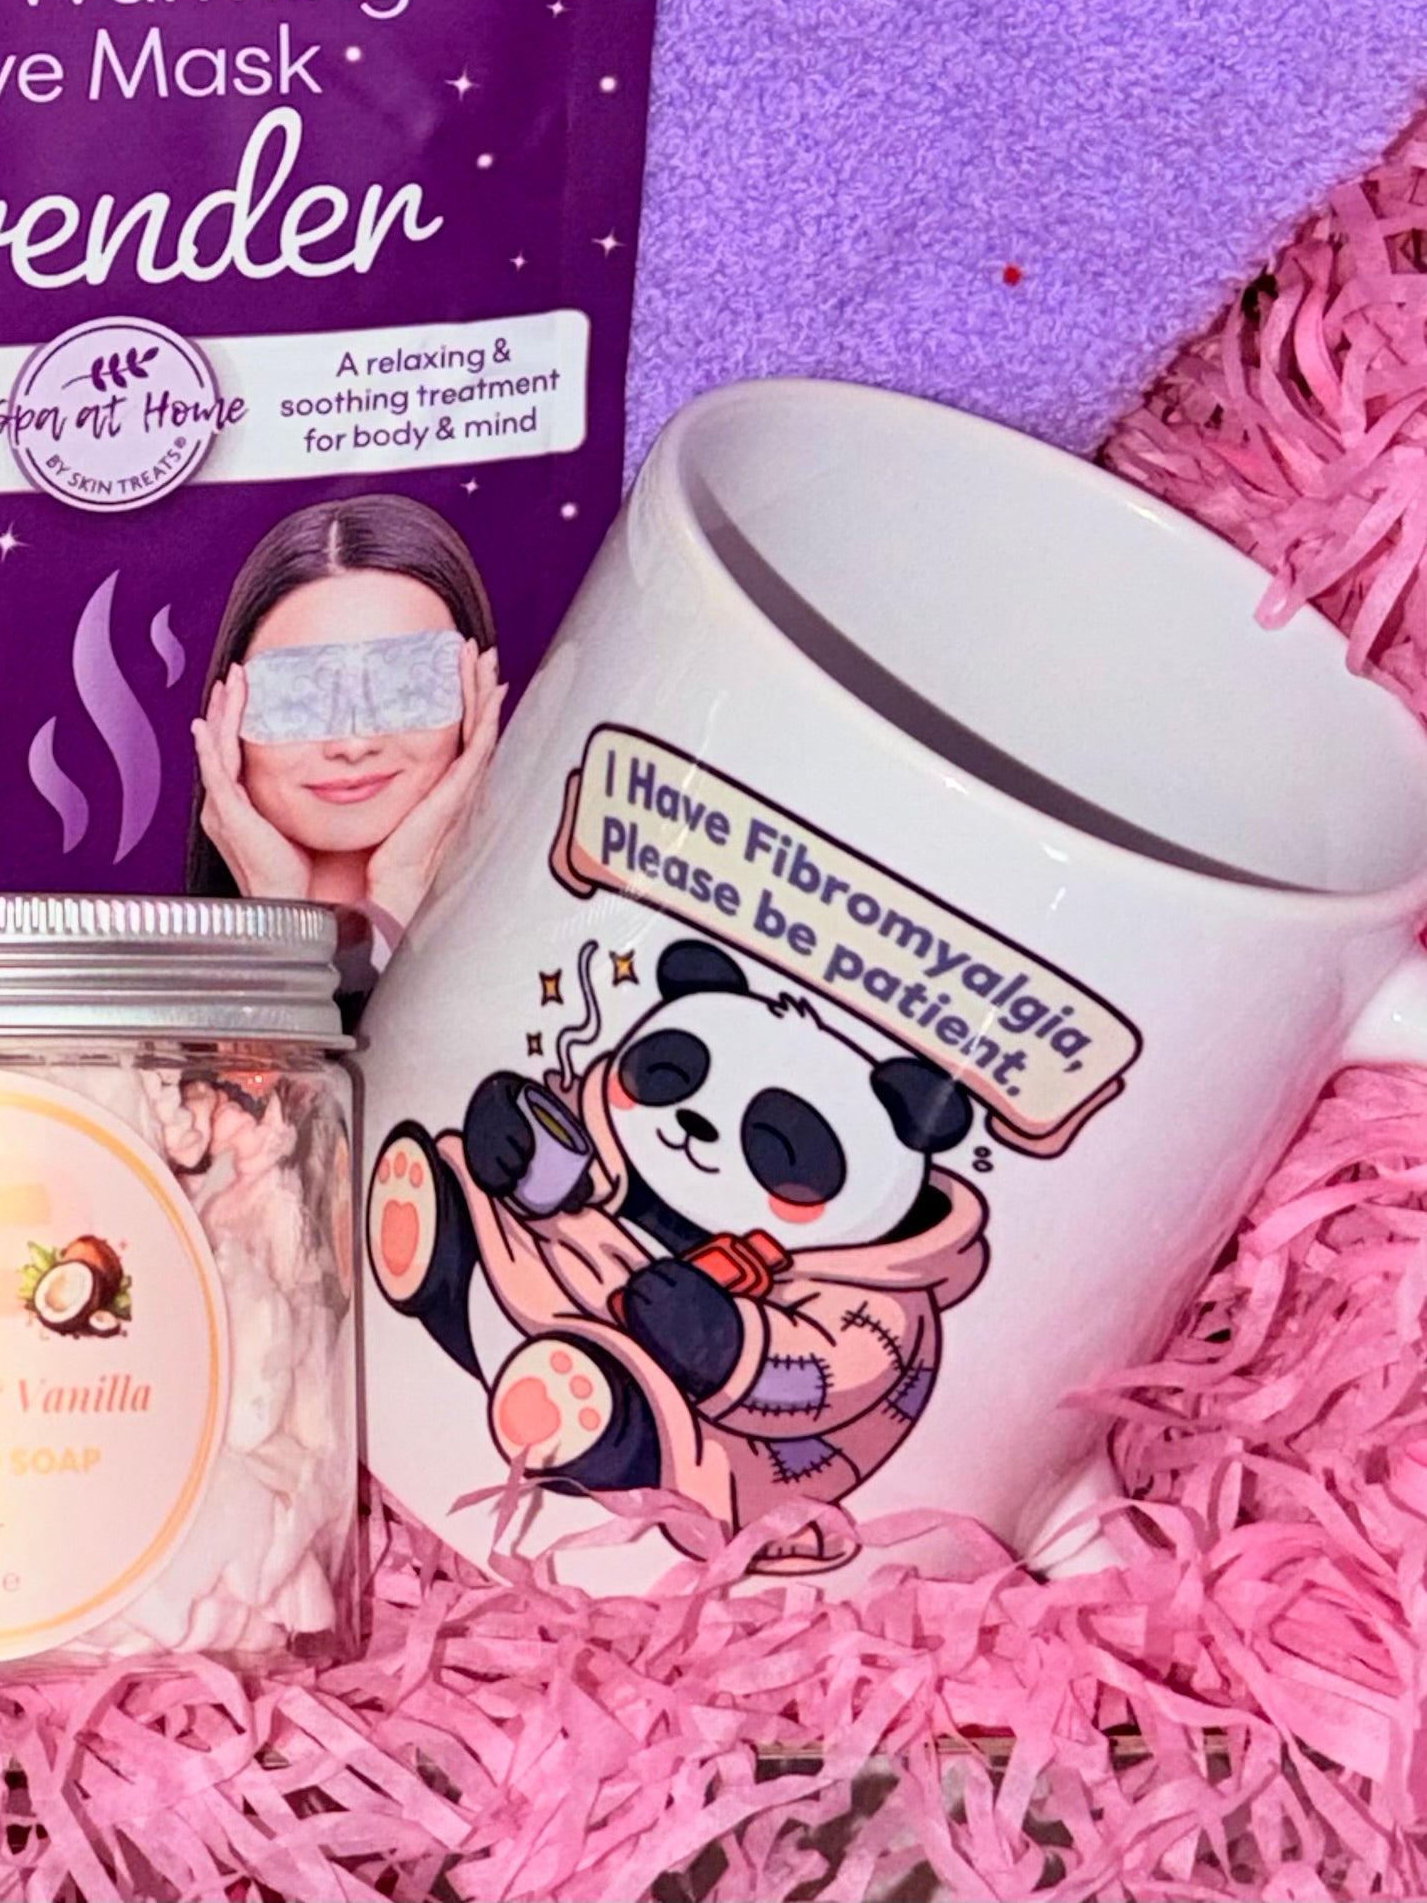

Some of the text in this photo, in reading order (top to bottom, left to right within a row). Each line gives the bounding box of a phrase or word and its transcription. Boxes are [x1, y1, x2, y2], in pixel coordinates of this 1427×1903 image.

[88, 22, 323, 102] Mask
[335, 337, 511, 378] A relaxing &
[75, 395, 127, 439] at
[144, 390, 250, 433] Home
[280, 368, 560, 418] soothing treatment
[304, 406, 537, 453] for body & mind
[45, 454, 70, 476] BY
[71, 472, 113, 496] SKIN
[604, 750, 1093, 1076] I Have Fibromyalgia,
[601, 817, 1027, 1099] Please be patient.
[18, 1373, 151, 1414] Vanilla
[10, 1446, 102, 1476] SOAP
